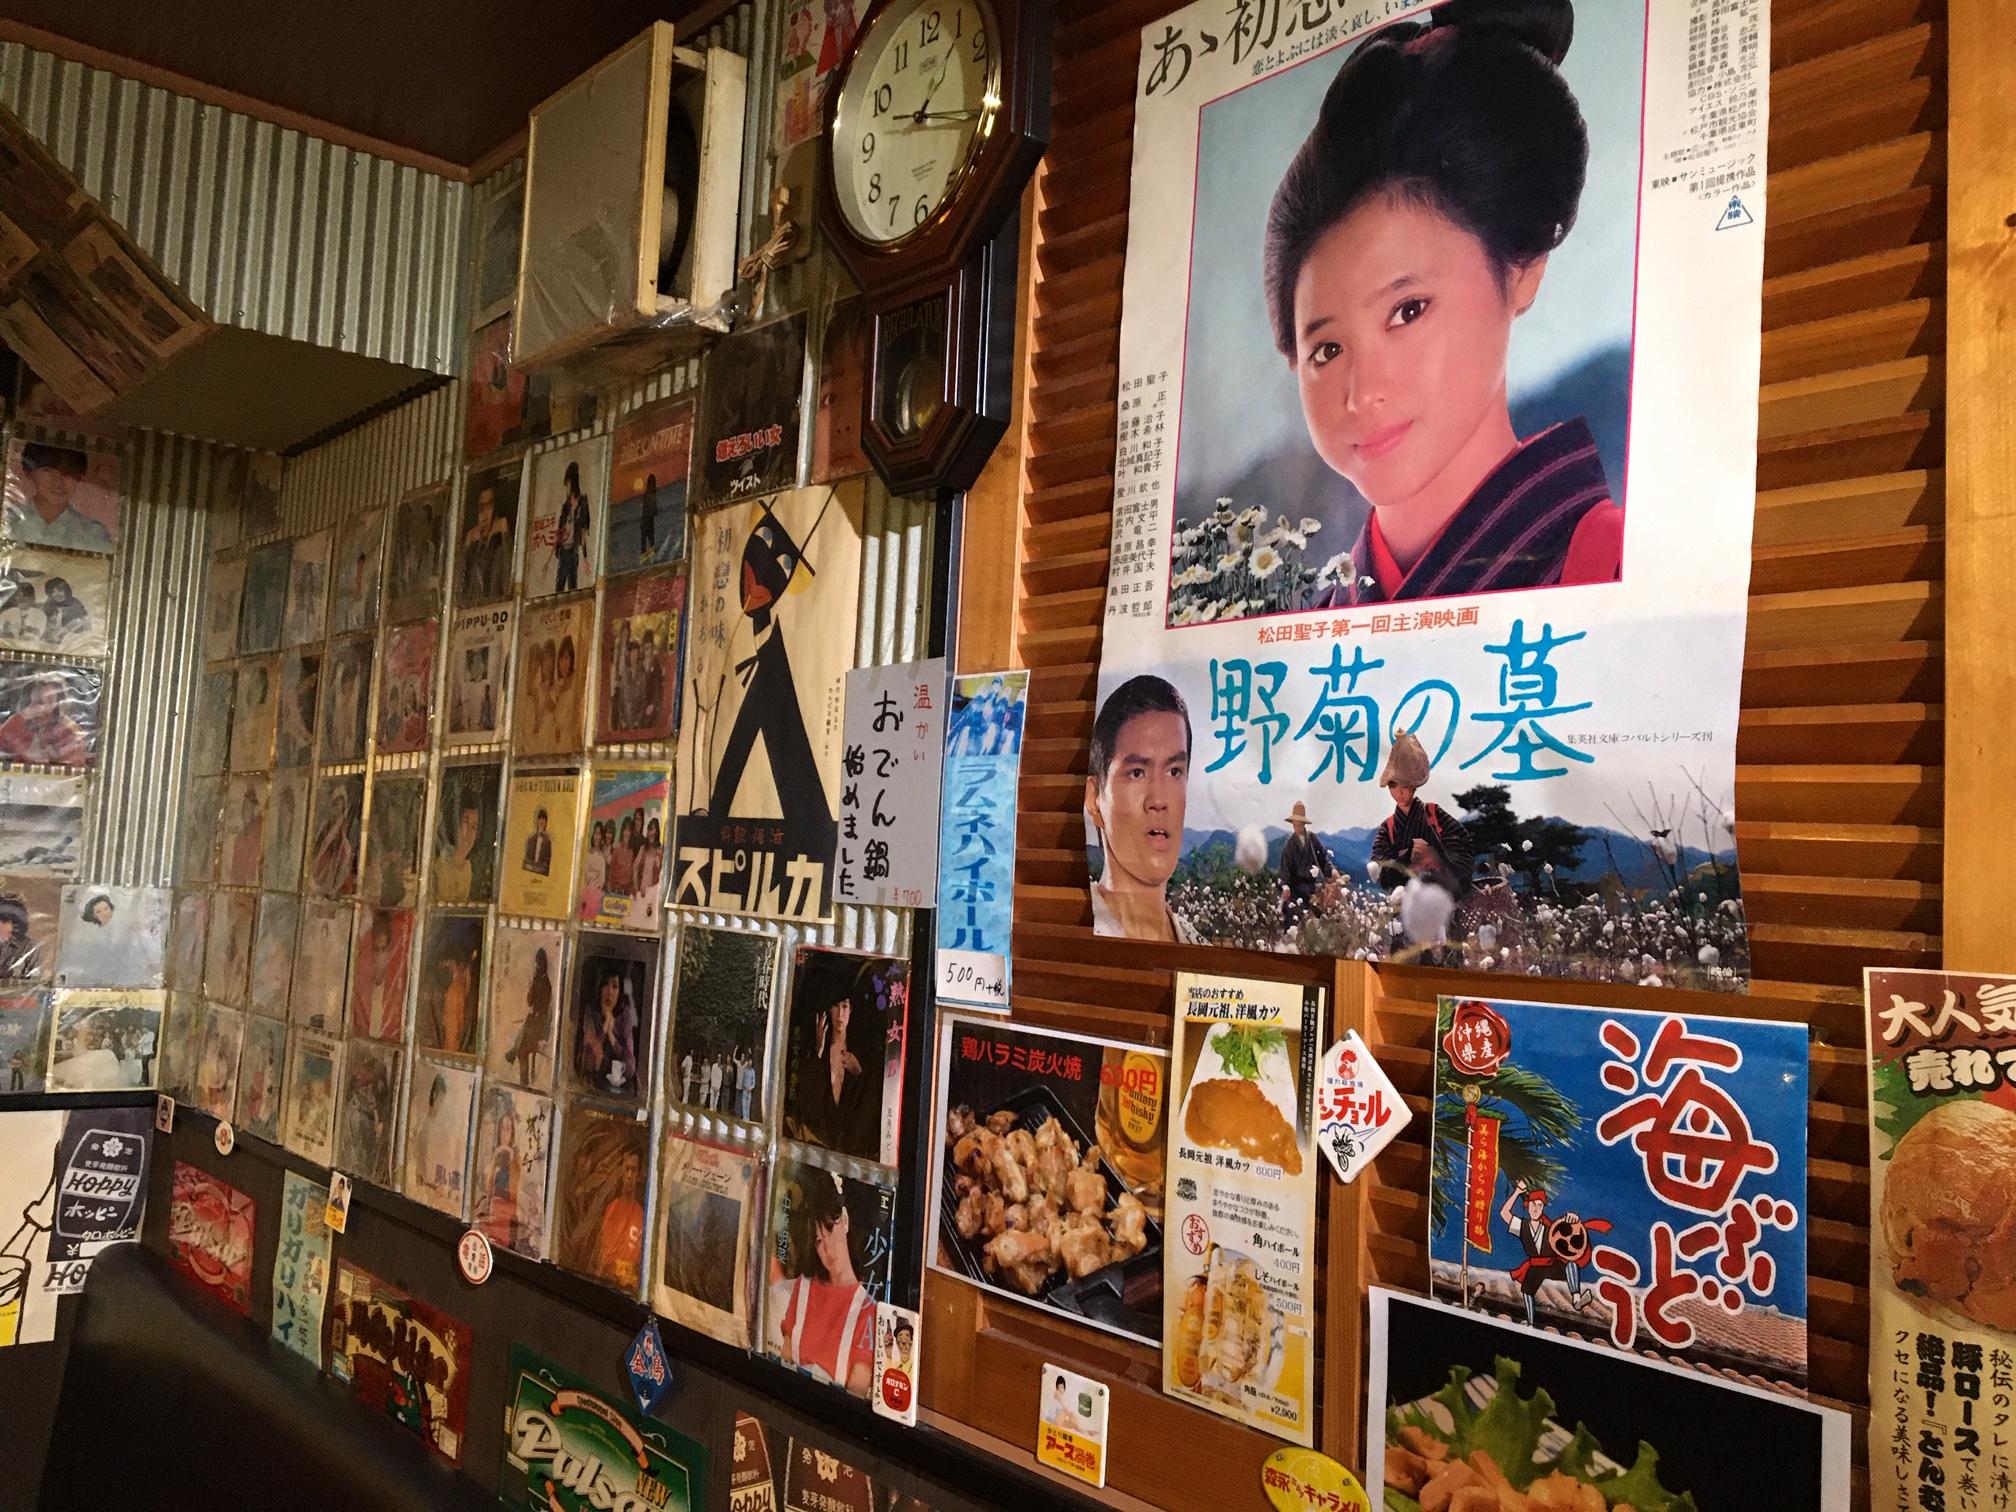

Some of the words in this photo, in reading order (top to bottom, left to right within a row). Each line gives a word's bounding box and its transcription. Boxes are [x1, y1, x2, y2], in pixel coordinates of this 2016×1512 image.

[918, 10, 942, 49] 12
[893, 38, 911, 76] 11
[872, 82, 894, 118] 10
[860, 131, 876, 164] 9
[867, 173, 883, 204] 8
[888, 195, 902, 228] 7
[913, 193, 929, 229] 6
[1121, 370, 1169, 393] 松田聖子
[730, 473, 761, 494] ツイスト
[1257, 605, 1480, 646] 松田聖子第一回主演映画
[1203, 618, 1596, 786] 野菊の墓
[912, 683, 933, 762] 温かい
[1566, 730, 1714, 746] 集英社文庫コバルトシリーズ刊
[862, 687, 905, 882] おでん鍋
[949, 762, 999, 953] ラムネハイボール
[1187, 985, 1245, 1001] 当店のおすすめ
[1186, 1000, 1281, 1021] 長岡元祖、洋風カツ
[961, 1036, 1084, 1081] 鶏ハラミ炭火焼
[1099, 1062, 1159, 1097] 600円
[1319, 1087, 1393, 1128] ンチョール
[1178, 1147, 1214, 1165] 長岡元祖
[1215, 1153, 1251, 1173] 洋風カツ
[1255, 1164, 1283, 1181] 600円
[65, 1171, 137, 1198] Hoppy
[63, 1199, 119, 1222] ホッピー
[1252, 1232, 1301, 1258] 角ハイボール
[857, 1226, 890, 1351] 少女A
[1254, 1269, 1301, 1292] しそハイボール
[1275, 1298, 1302, 1316] 500円
[1950, 1340, 1985, 1511] 豚ロースで巻い
[635, 1471, 672, 1511] NEW
